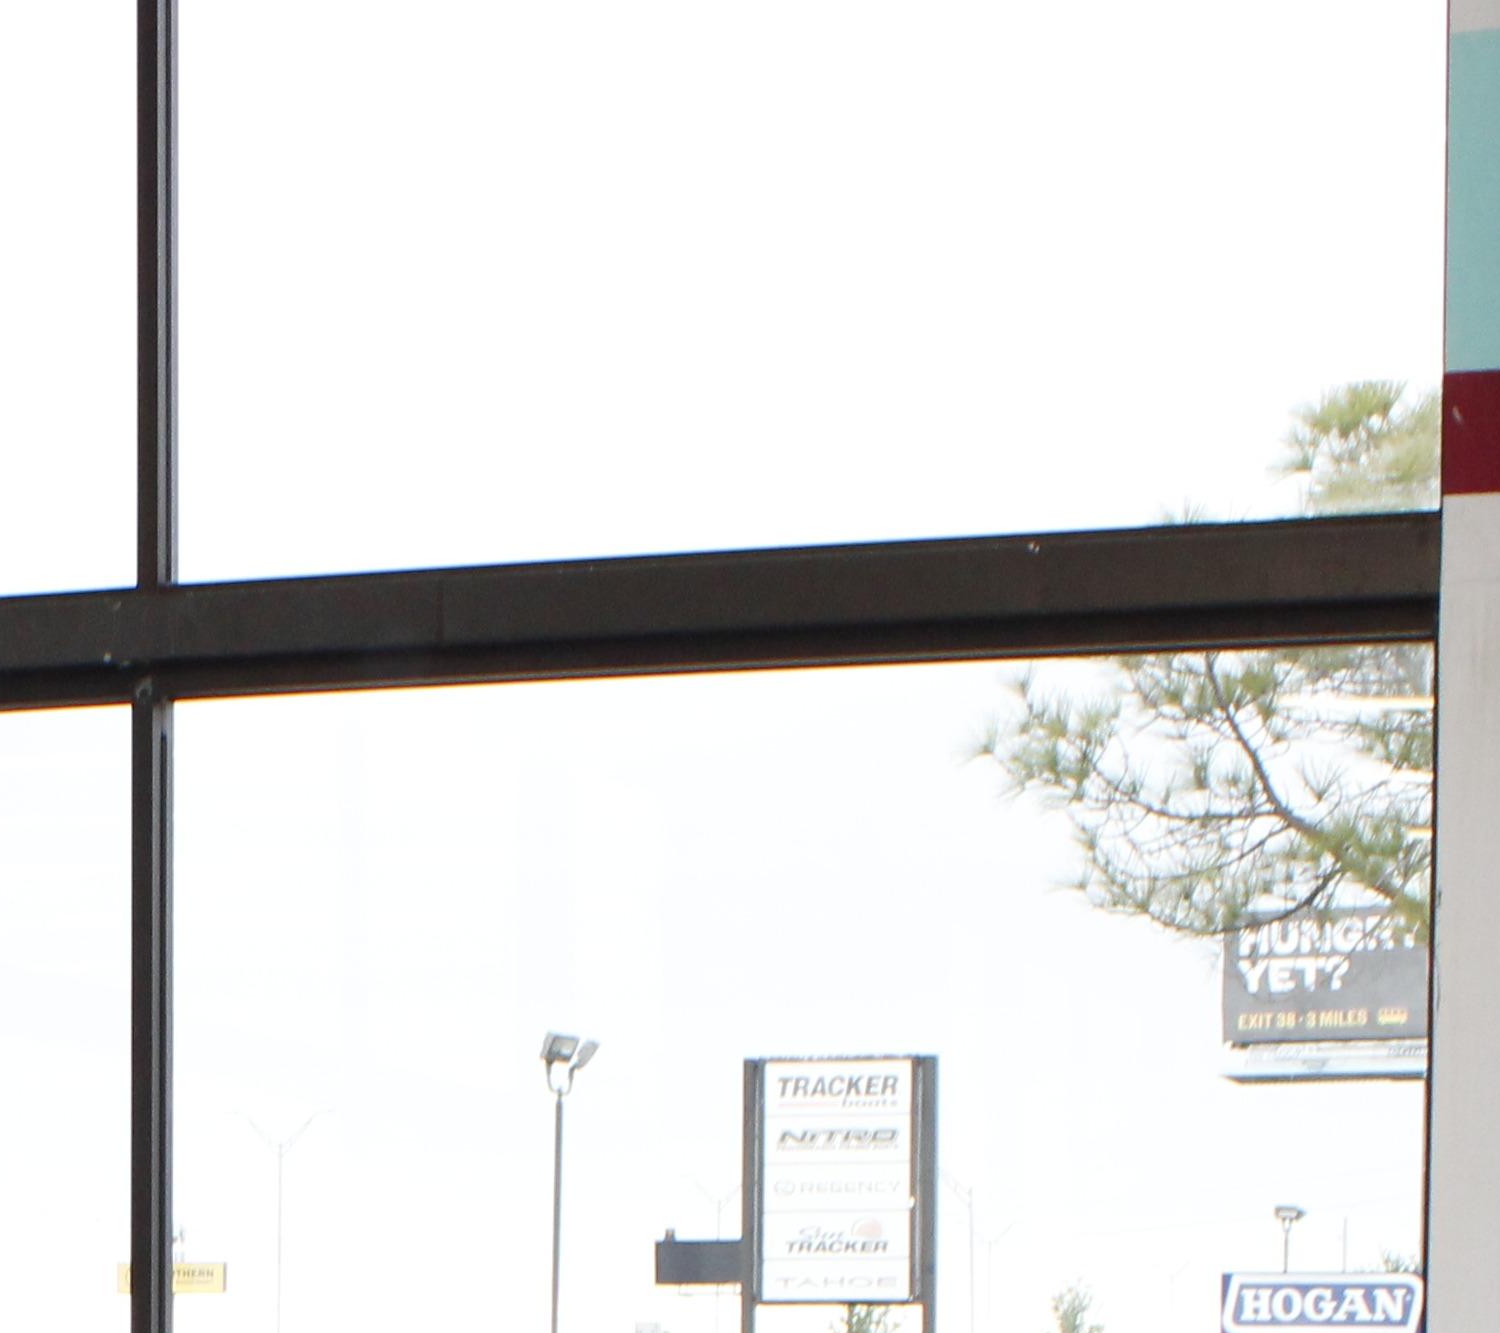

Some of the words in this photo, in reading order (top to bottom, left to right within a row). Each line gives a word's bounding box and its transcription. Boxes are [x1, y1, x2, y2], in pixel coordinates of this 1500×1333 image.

[1237, 954, 1350, 995] YET?
[1238, 1012, 1272, 1031] EXIT
[1319, 1008, 1369, 1027] MILES
[777, 1075, 899, 1098] TRACKER
[800, 1181, 901, 1194] REGENCY
[786, 1239, 890, 1254] TRACKER
[775, 1276, 898, 1289] TAHOE
[1239, 1287, 1408, 1322] HOGAN
